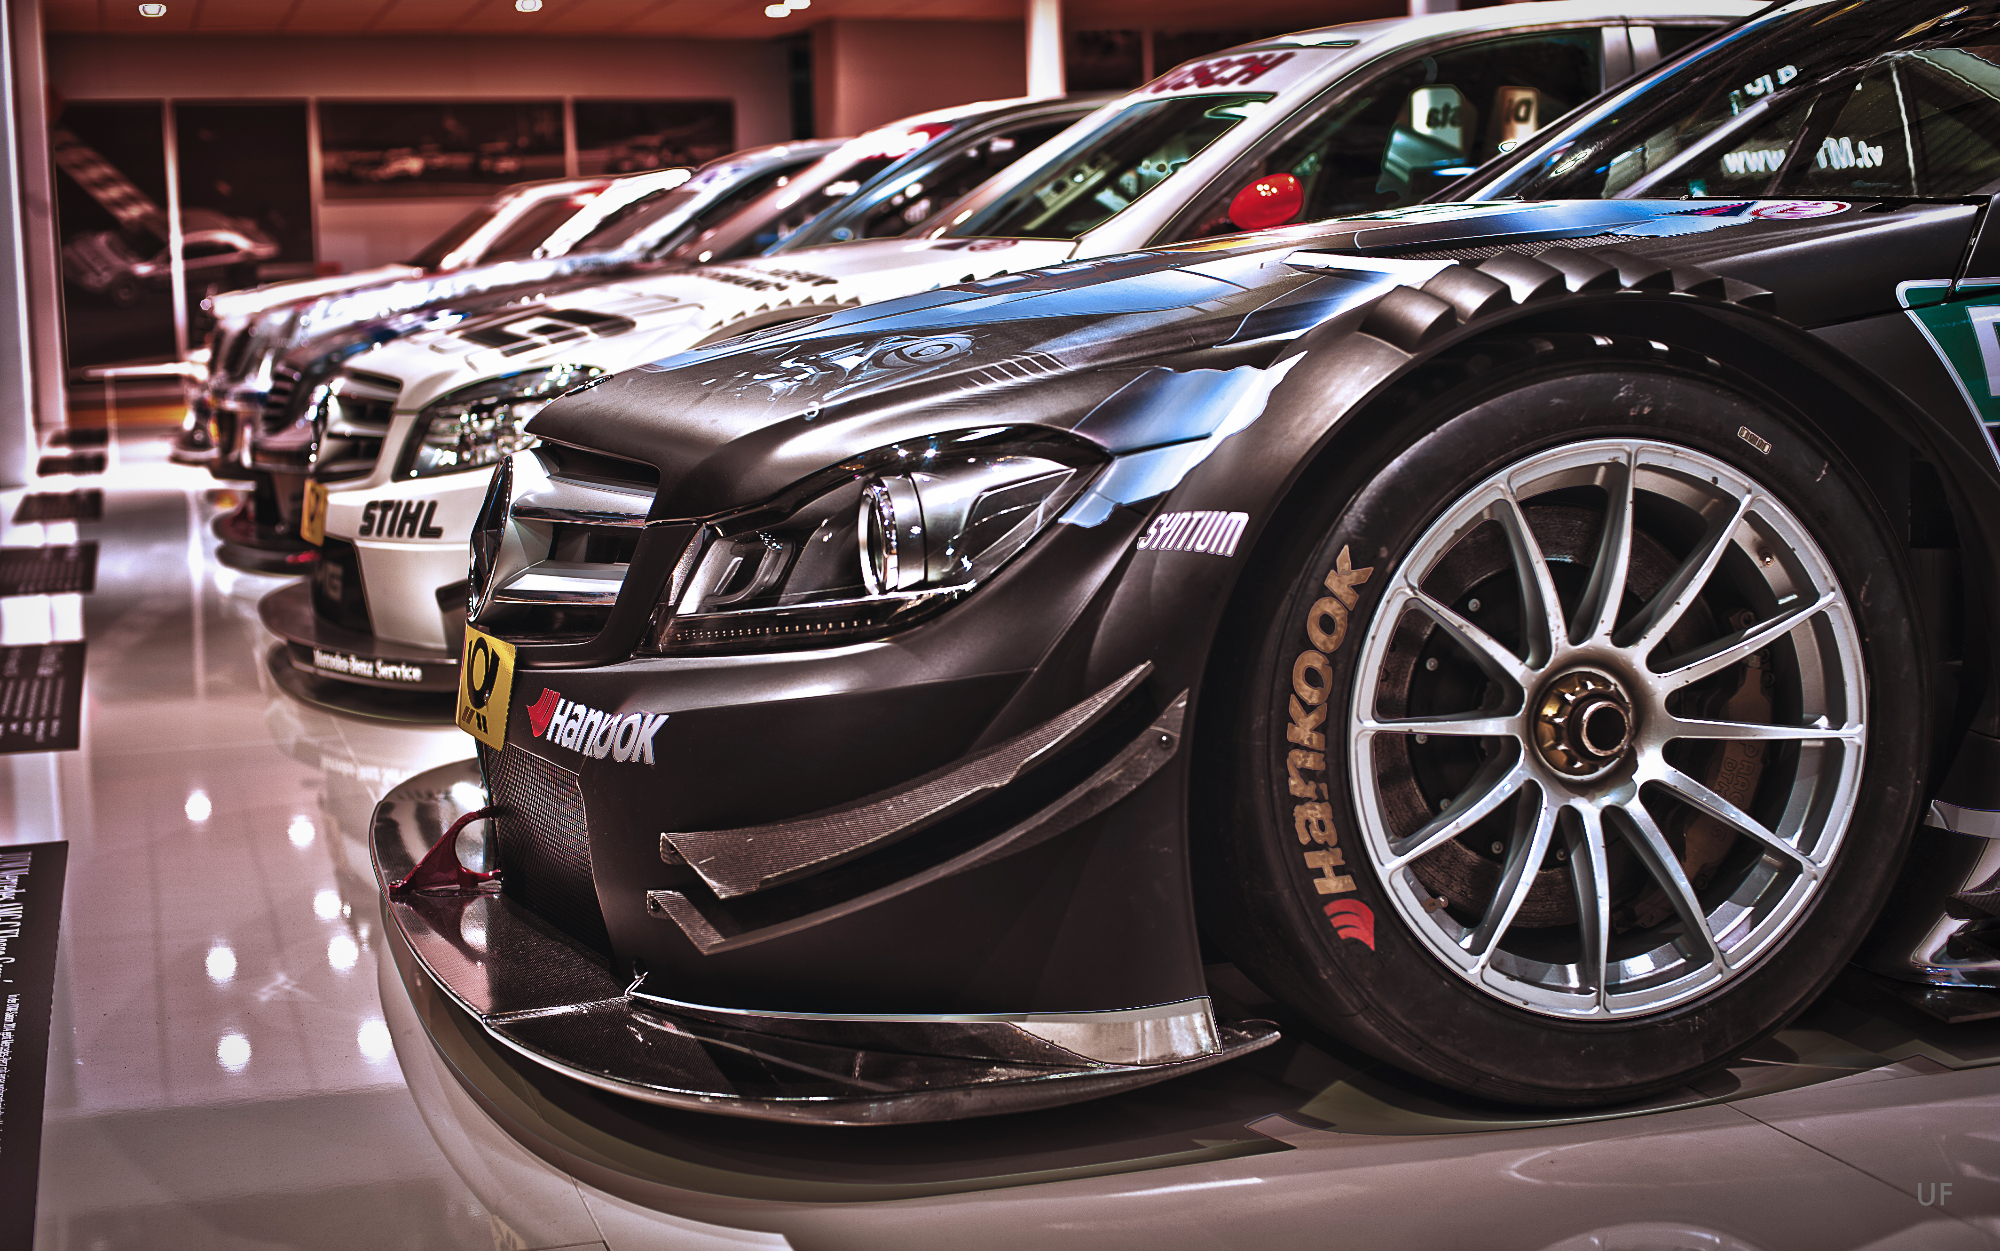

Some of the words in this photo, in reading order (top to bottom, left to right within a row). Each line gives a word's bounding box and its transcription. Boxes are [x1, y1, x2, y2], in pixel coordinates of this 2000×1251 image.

[1723, 136, 1884, 174] wwwTM.tv
[359, 500, 443, 538] STIHL
[1137, 511, 1249, 557] SYNTIUM
[313, 647, 374, 677] Mercedes-Benz
[375, 659, 422, 682] Service
